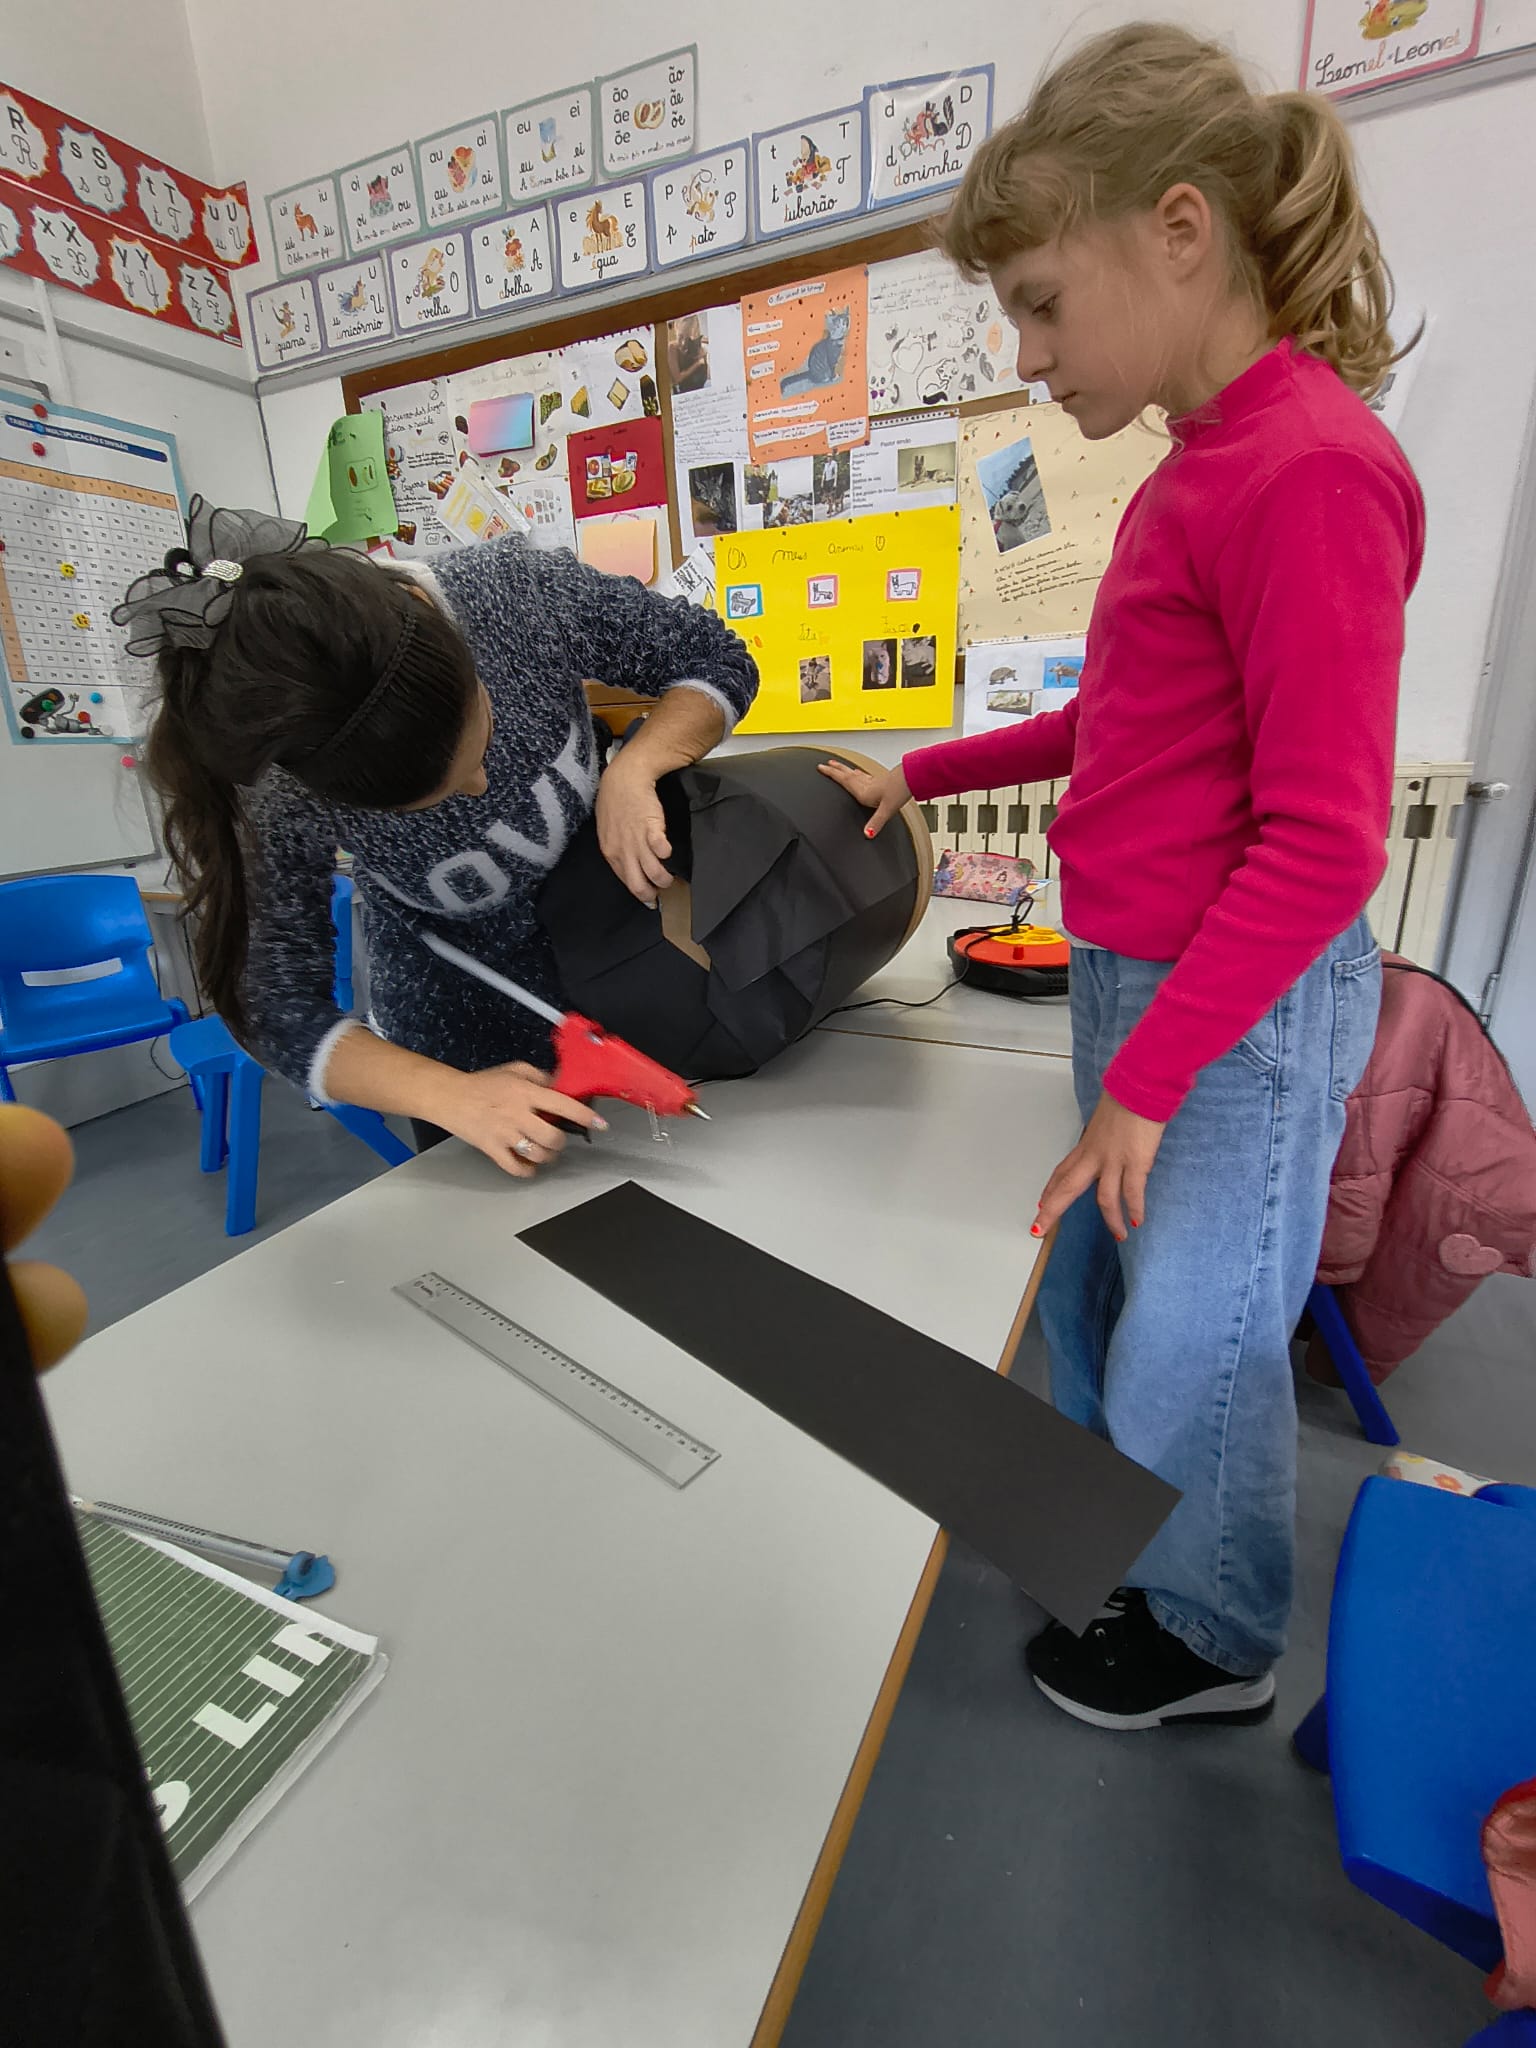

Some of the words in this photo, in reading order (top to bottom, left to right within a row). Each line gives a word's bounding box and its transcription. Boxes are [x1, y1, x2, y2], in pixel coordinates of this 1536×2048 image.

[668, 65, 685, 84] ão
[613, 87, 629, 103] ão
[960, 85, 973, 104] D
[569, 100, 581, 118] ei
[614, 109, 630, 124] ãe
[885, 98, 895, 118] d
[7, 106, 27, 134] R
[516, 120, 531, 134] eu
[476, 130, 487, 147] ai
[615, 130, 631, 146] õe
[838, 121, 850, 139] T
[955, 122, 972, 151] D
[92, 147, 107, 169] S
[430, 150, 443, 163] au
[573, 142, 586, 158] ei
[770, 144, 777, 160] t
[886, 146, 897, 167] d
[391, 163, 404, 176] ou
[519, 160, 534, 174] eu
[724, 158, 733, 176] P
[894, 150, 963, 187] doninha
[482, 170, 494, 185] ai
[146, 176, 156, 196] t
[163, 182, 176, 204] T
[434, 188, 448, 200] au
[665, 184, 674, 200] p
[771, 184, 780, 204] t
[623, 192, 633, 208] E
[784, 194, 838, 224] tubarão
[226, 202, 237, 221] U
[569, 211, 577, 222] e
[61, 221, 82, 247] X
[530, 218, 540, 233] A
[666, 224, 677, 245] p
[482, 235, 490, 247] a
[689, 225, 717, 254] pato
[445, 242, 455, 256] O
[135, 249, 149, 270] Y
[401, 258, 408, 268] o
[531, 248, 543, 272] A
[368, 265, 377, 280] U
[485, 274, 493, 284] a
[203, 276, 217, 297] Z
[327, 282, 334, 292] u
[450, 271, 459, 293] O
[499, 273, 533, 300] abelha
[405, 292, 413, 304] o
[417, 296, 451, 320] ovelha
